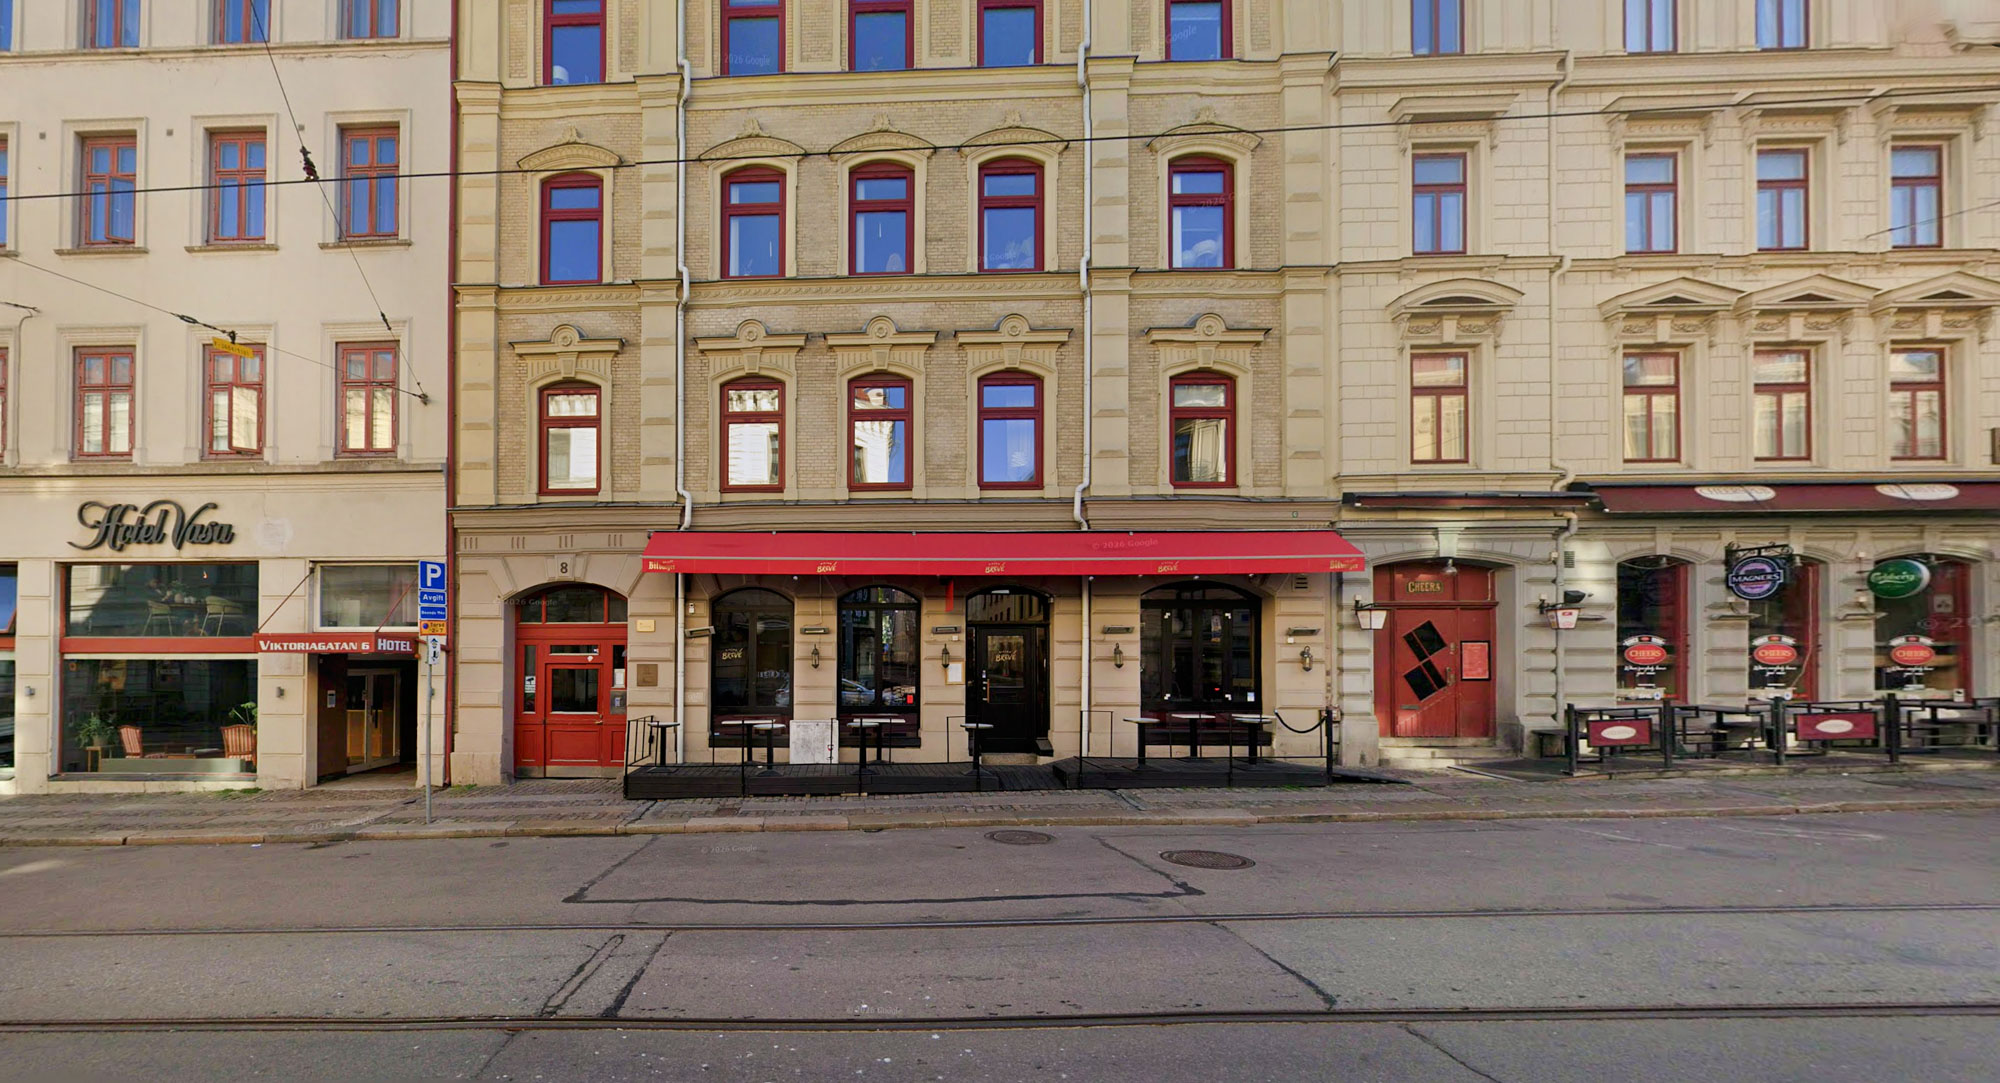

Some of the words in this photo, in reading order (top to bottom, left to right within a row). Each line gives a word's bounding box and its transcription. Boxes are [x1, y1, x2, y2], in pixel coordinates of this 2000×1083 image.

[67, 500, 168, 551] Hotel
[140, 500, 235, 550] Vasa
[560, 561, 568, 574] 8
[426, 563, 442, 587] P
[422, 593, 444, 602] Avgift
[258, 640, 357, 650] VIKTORIAGATAN
[361, 642, 370, 650] 6
[377, 638, 412, 651] HOTEL
